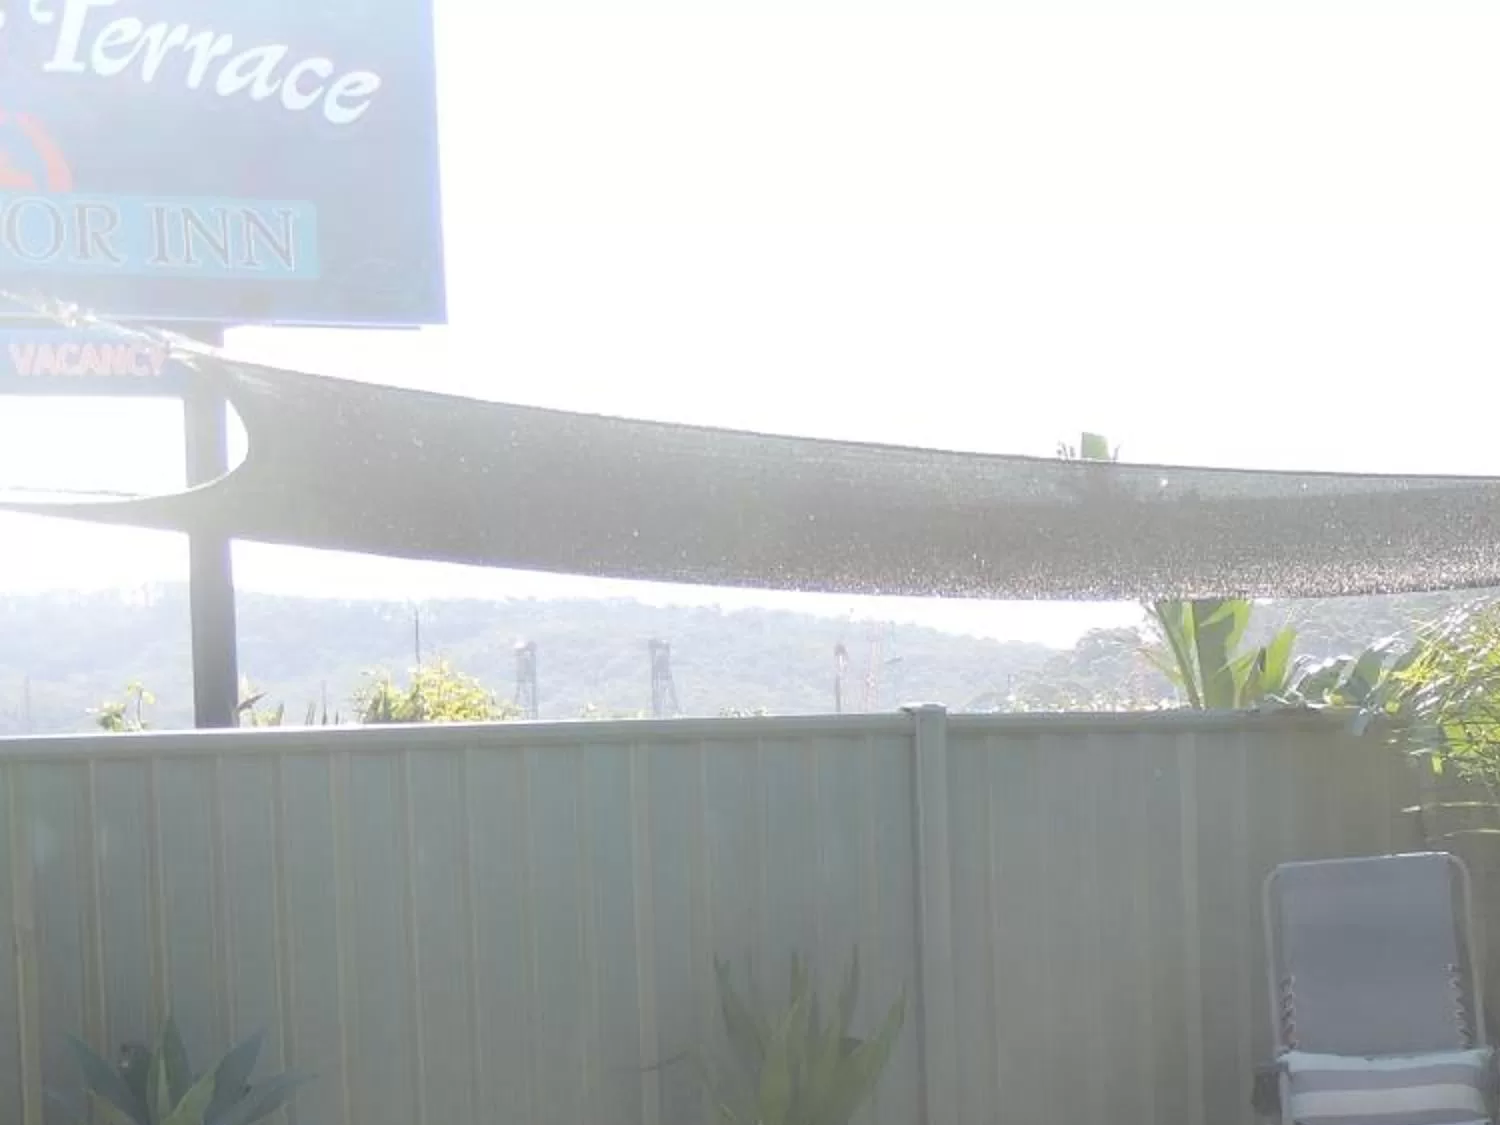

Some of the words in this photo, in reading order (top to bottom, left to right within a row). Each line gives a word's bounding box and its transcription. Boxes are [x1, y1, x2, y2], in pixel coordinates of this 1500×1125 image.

[28, 0, 382, 125] Terrace
[145, 202, 300, 273] INN
[8, 342, 168, 377] VACANCY
